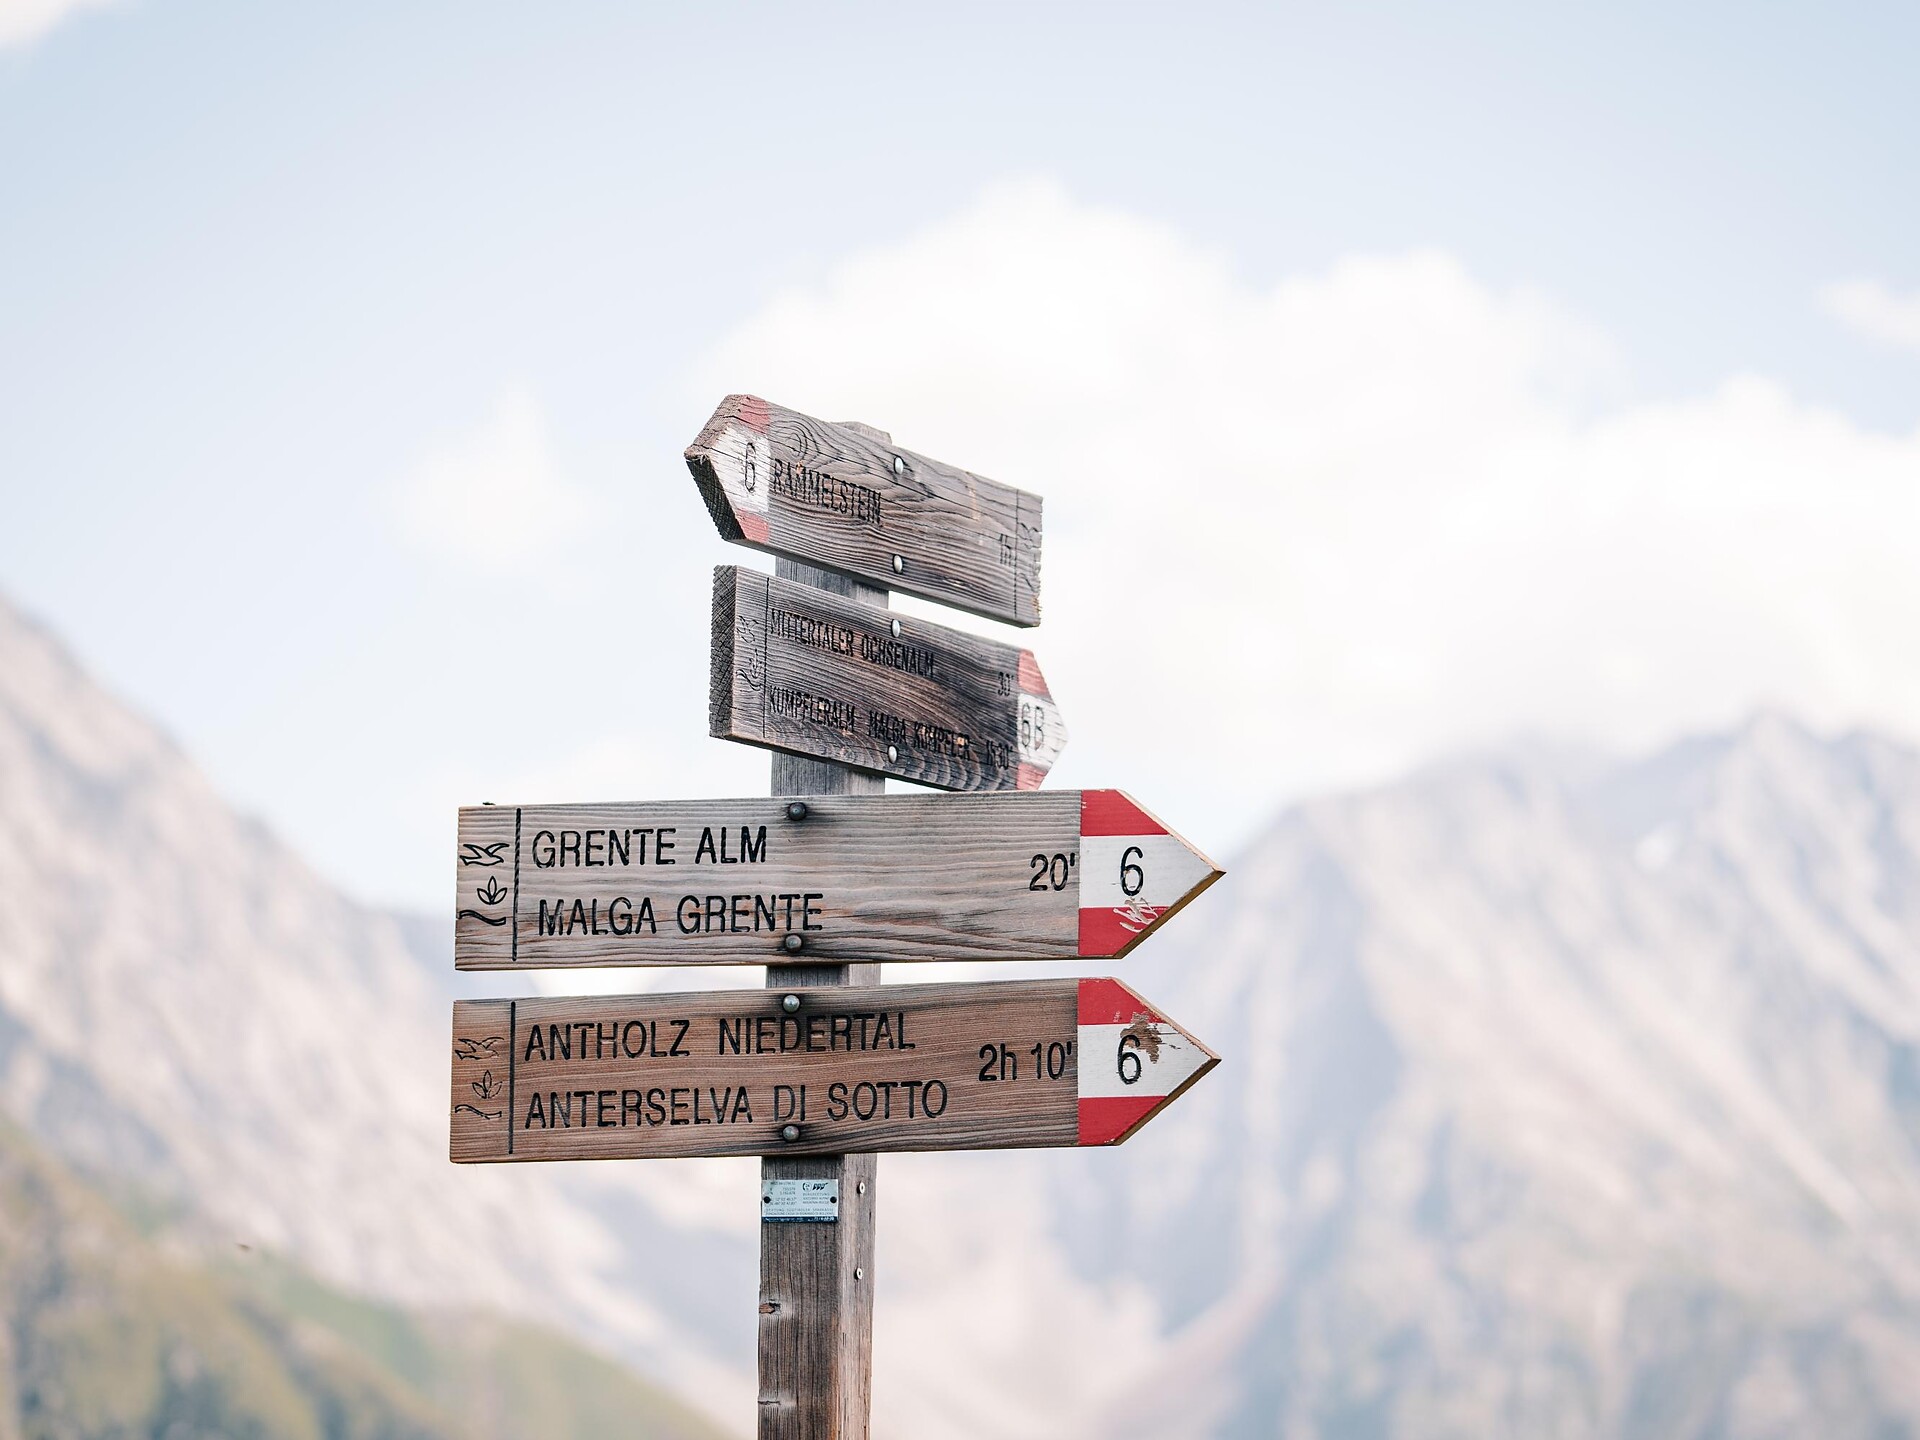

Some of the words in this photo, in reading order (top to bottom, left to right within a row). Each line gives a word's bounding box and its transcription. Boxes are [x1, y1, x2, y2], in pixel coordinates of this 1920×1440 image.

[744, 442, 756, 492] 6
[773, 457, 882, 525] RAMMELSTEIN
[770, 607, 854, 657] MITTERTALER
[861, 633, 934, 678] OCHSENALM
[769, 685, 855, 733] KUMPFLERALM
[868, 710, 907, 745] MALGA
[913, 721, 970, 761] KUMPFLER
[1021, 702, 1045, 751] 6B
[532, 827, 677, 869] GRENTE
[694, 825, 768, 865] ALM
[1029, 852, 1076, 892] 20'
[1120, 846, 1144, 896] 6
[538, 896, 658, 937] MALGA
[676, 893, 824, 935] GRENTE
[524, 1018, 691, 1062] ANTHOLZ
[718, 1011, 916, 1056] NIEDERTAL
[978, 1043, 1018, 1082] 2h
[1030, 1041, 1073, 1080] 10'
[1117, 1034, 1142, 1085] 6
[524, 1085, 754, 1130] ANTERSELVA
[773, 1083, 806, 1123] DI
[826, 1079, 949, 1122] SOTTO
